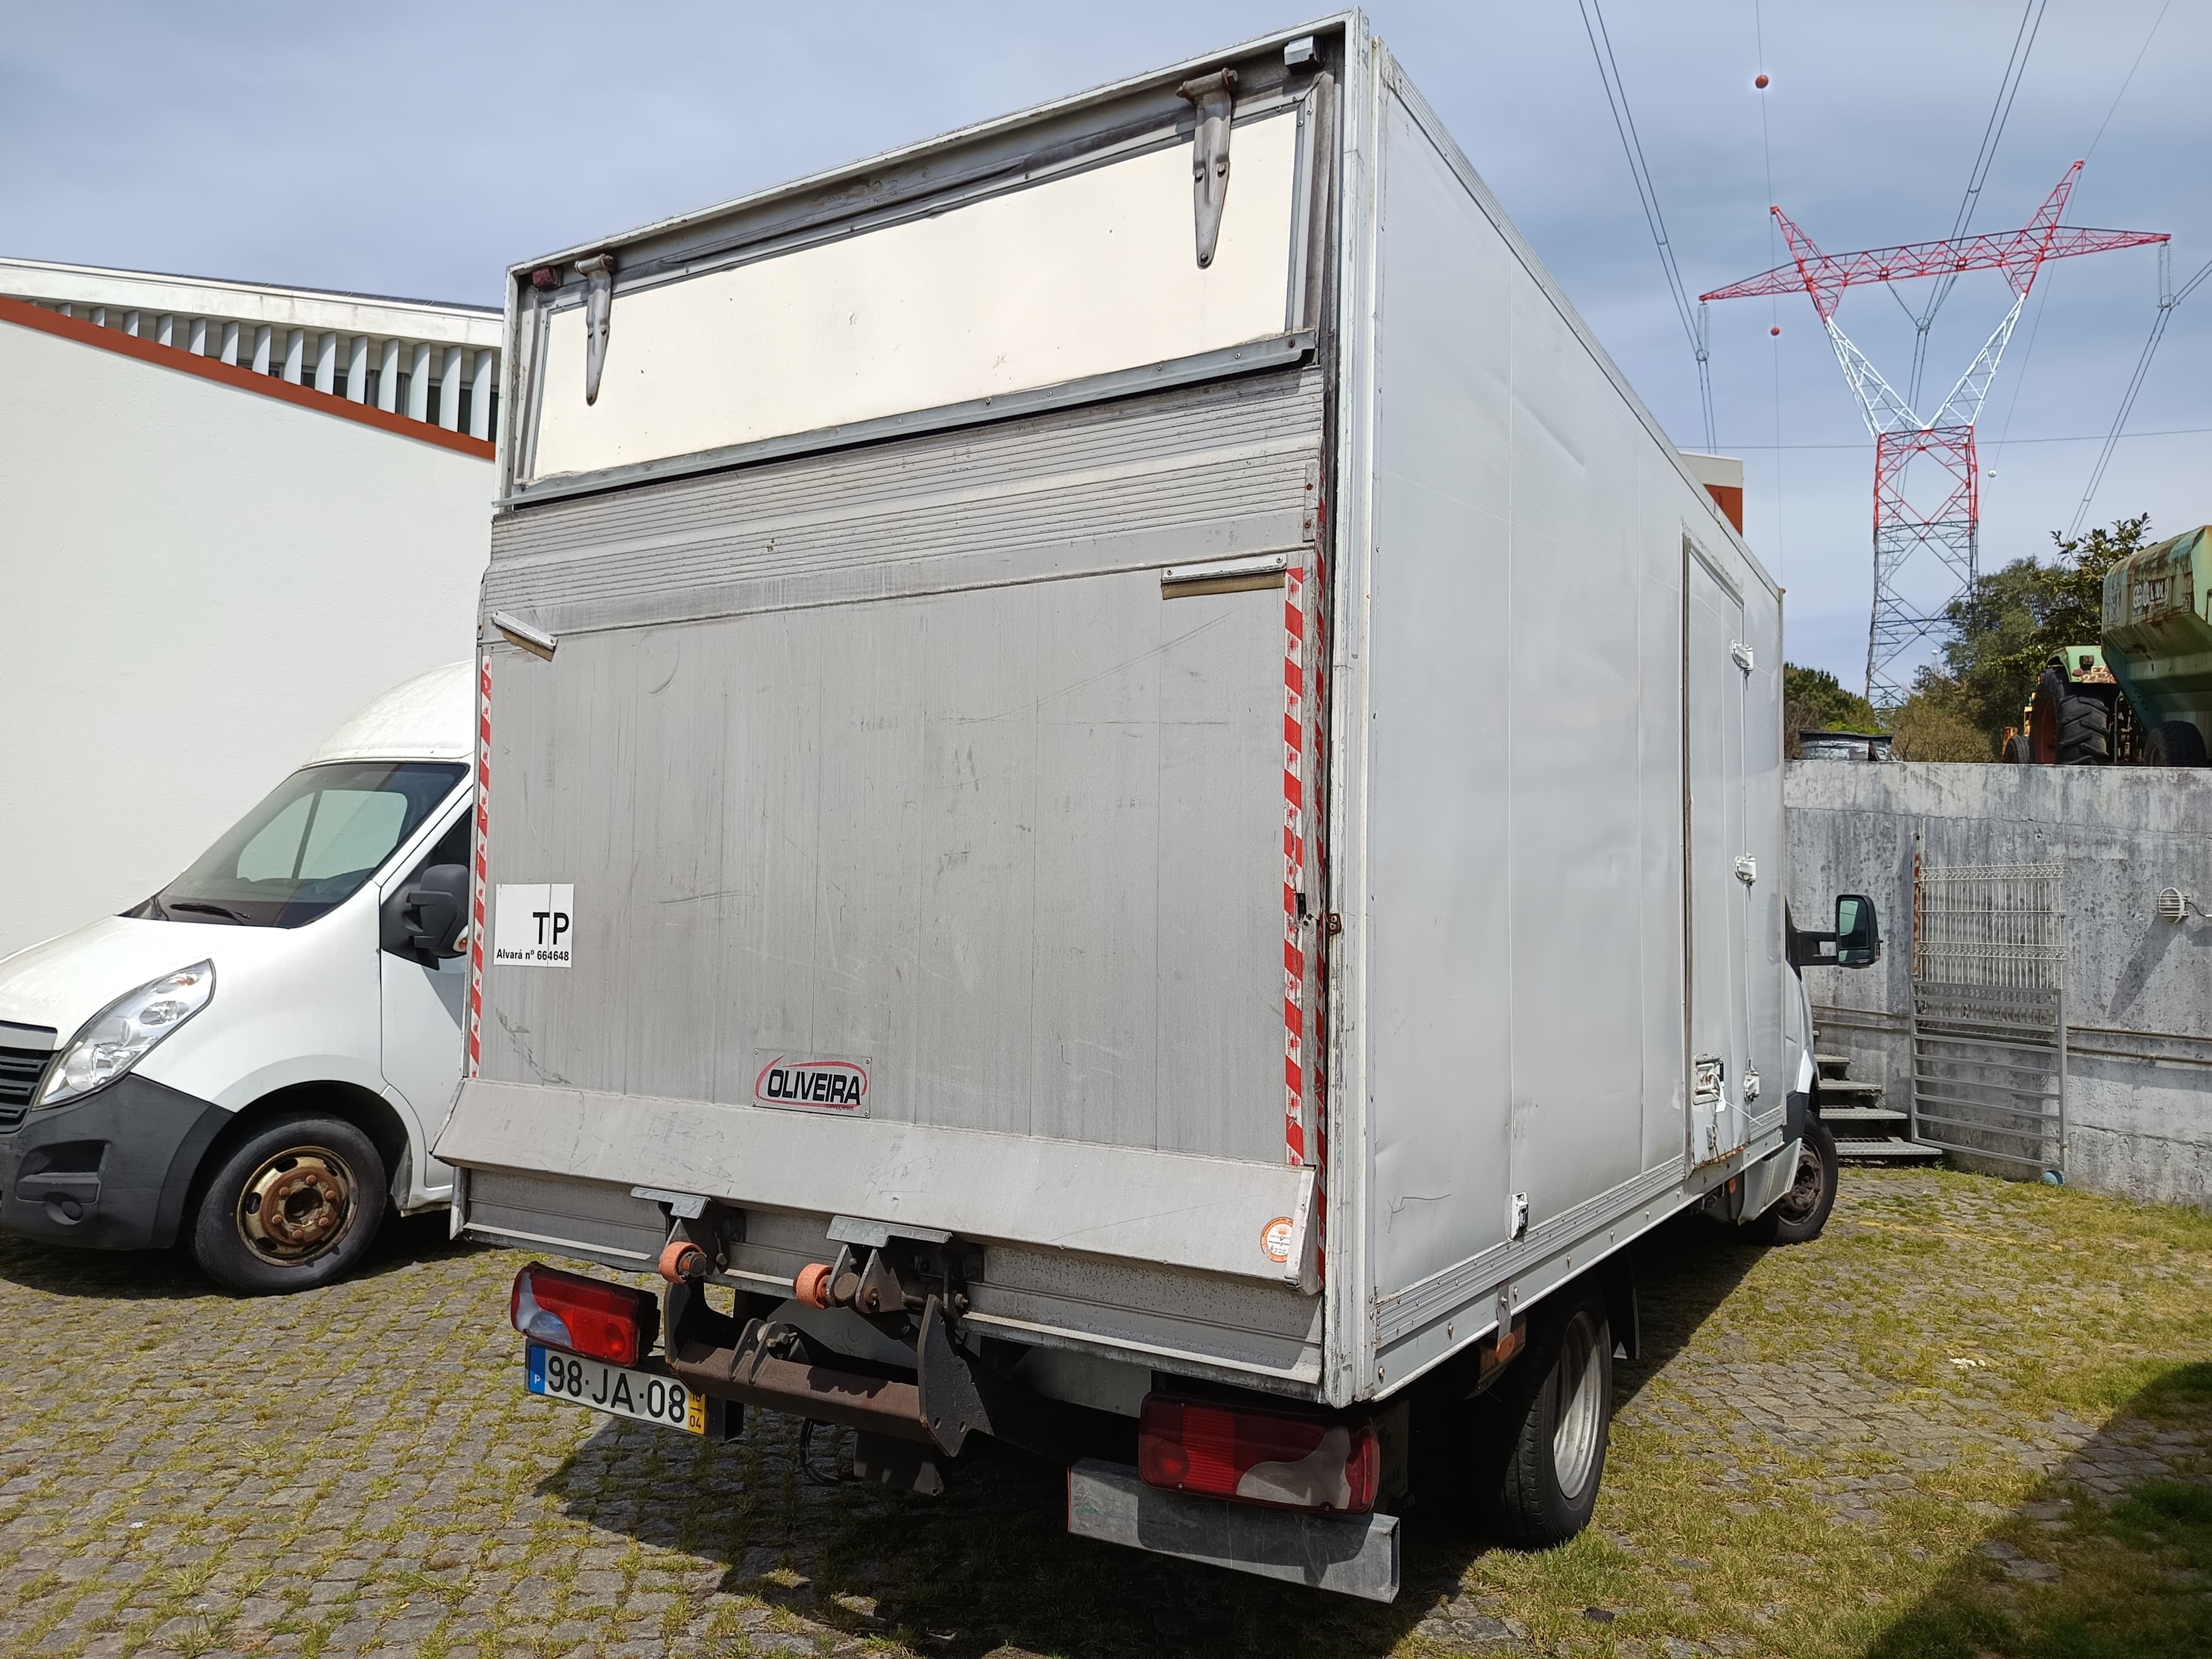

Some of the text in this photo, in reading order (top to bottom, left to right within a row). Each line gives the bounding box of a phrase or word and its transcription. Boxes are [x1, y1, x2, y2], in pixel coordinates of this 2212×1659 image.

[532, 912, 570, 945] TP
[496, 949, 523, 960] Alvará
[537, 950, 569, 961] 664648
[767, 1069, 861, 1105] OLIVEIRA
[534, 1374, 541, 1384] P
[690, 1415, 702, 1430] 04
